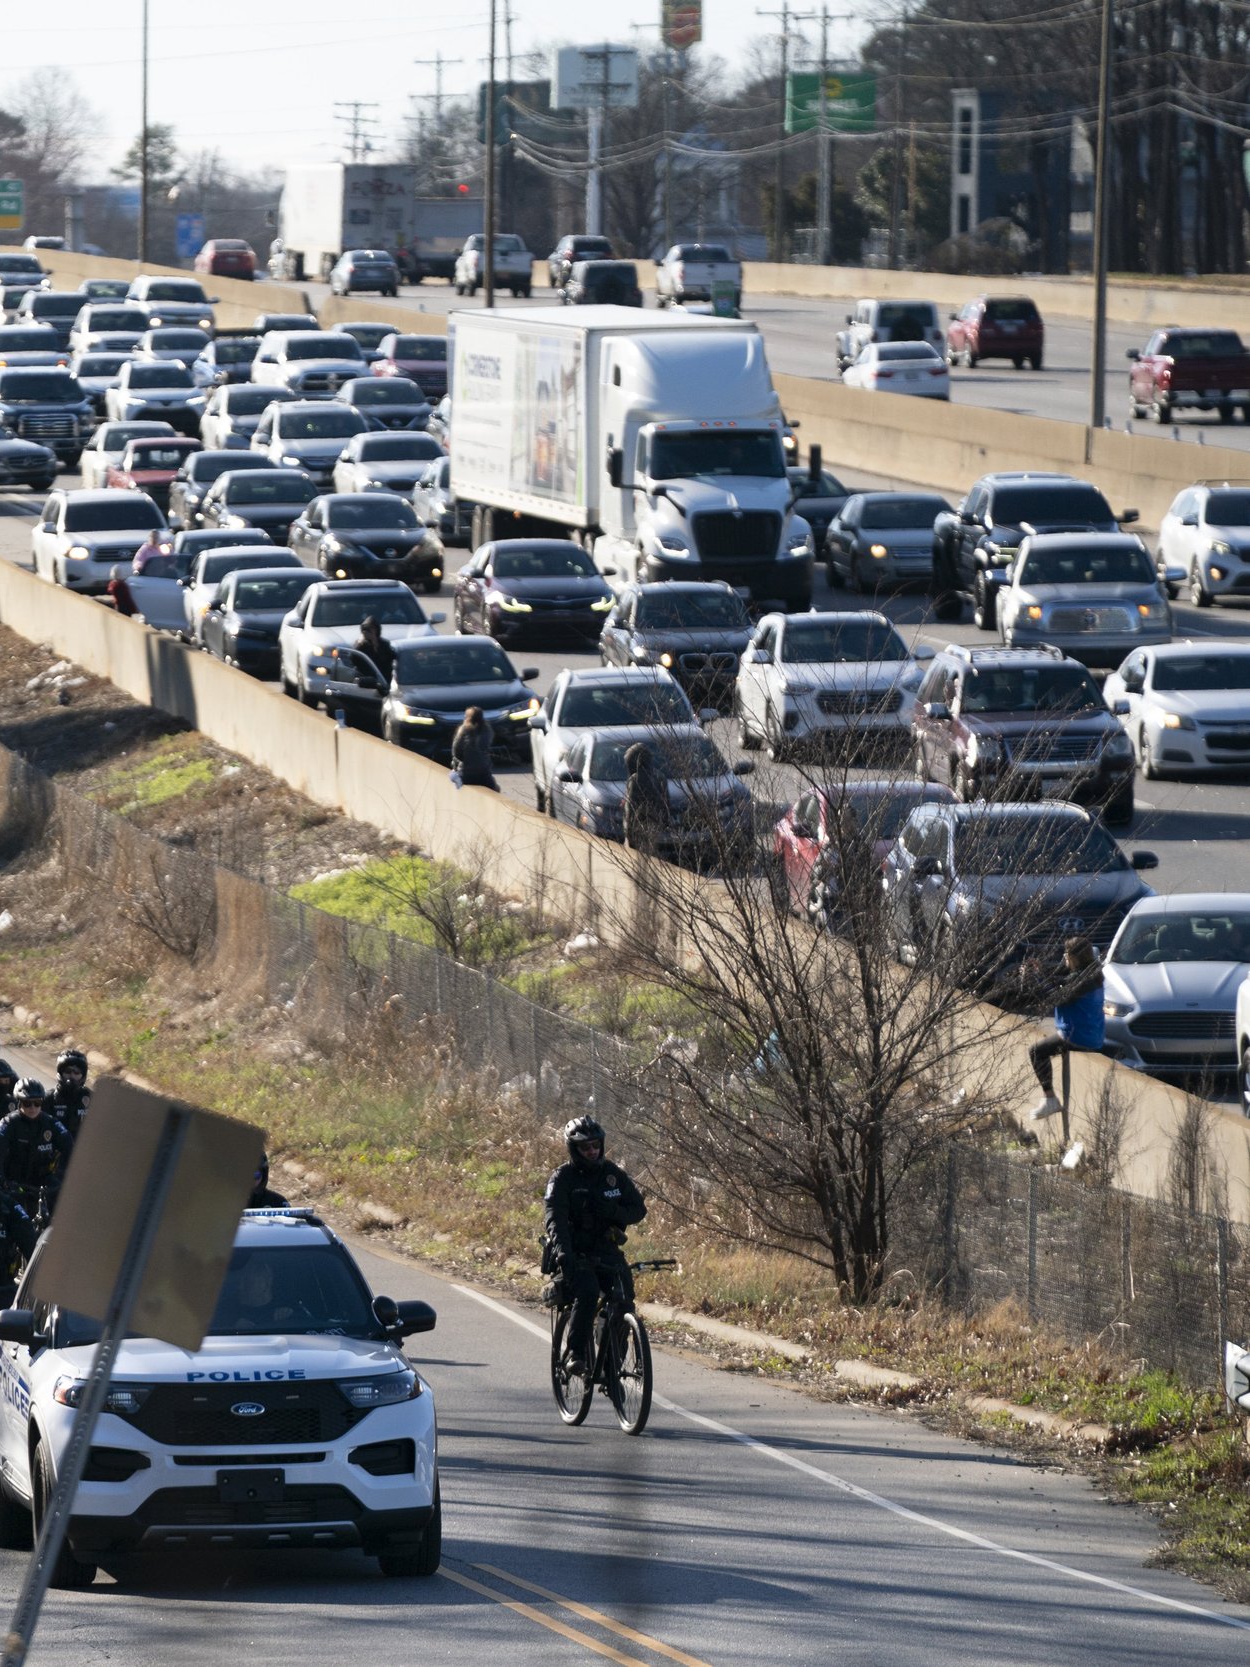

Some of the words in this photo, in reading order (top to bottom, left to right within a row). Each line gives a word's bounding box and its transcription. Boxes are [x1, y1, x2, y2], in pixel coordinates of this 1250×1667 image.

[37, 1143, 53, 1151] POLICE
[603, 1188, 622, 1198] POLICE
[186, 1369, 306, 1382] POLICE
[238, 1405, 257, 1413] Ford
